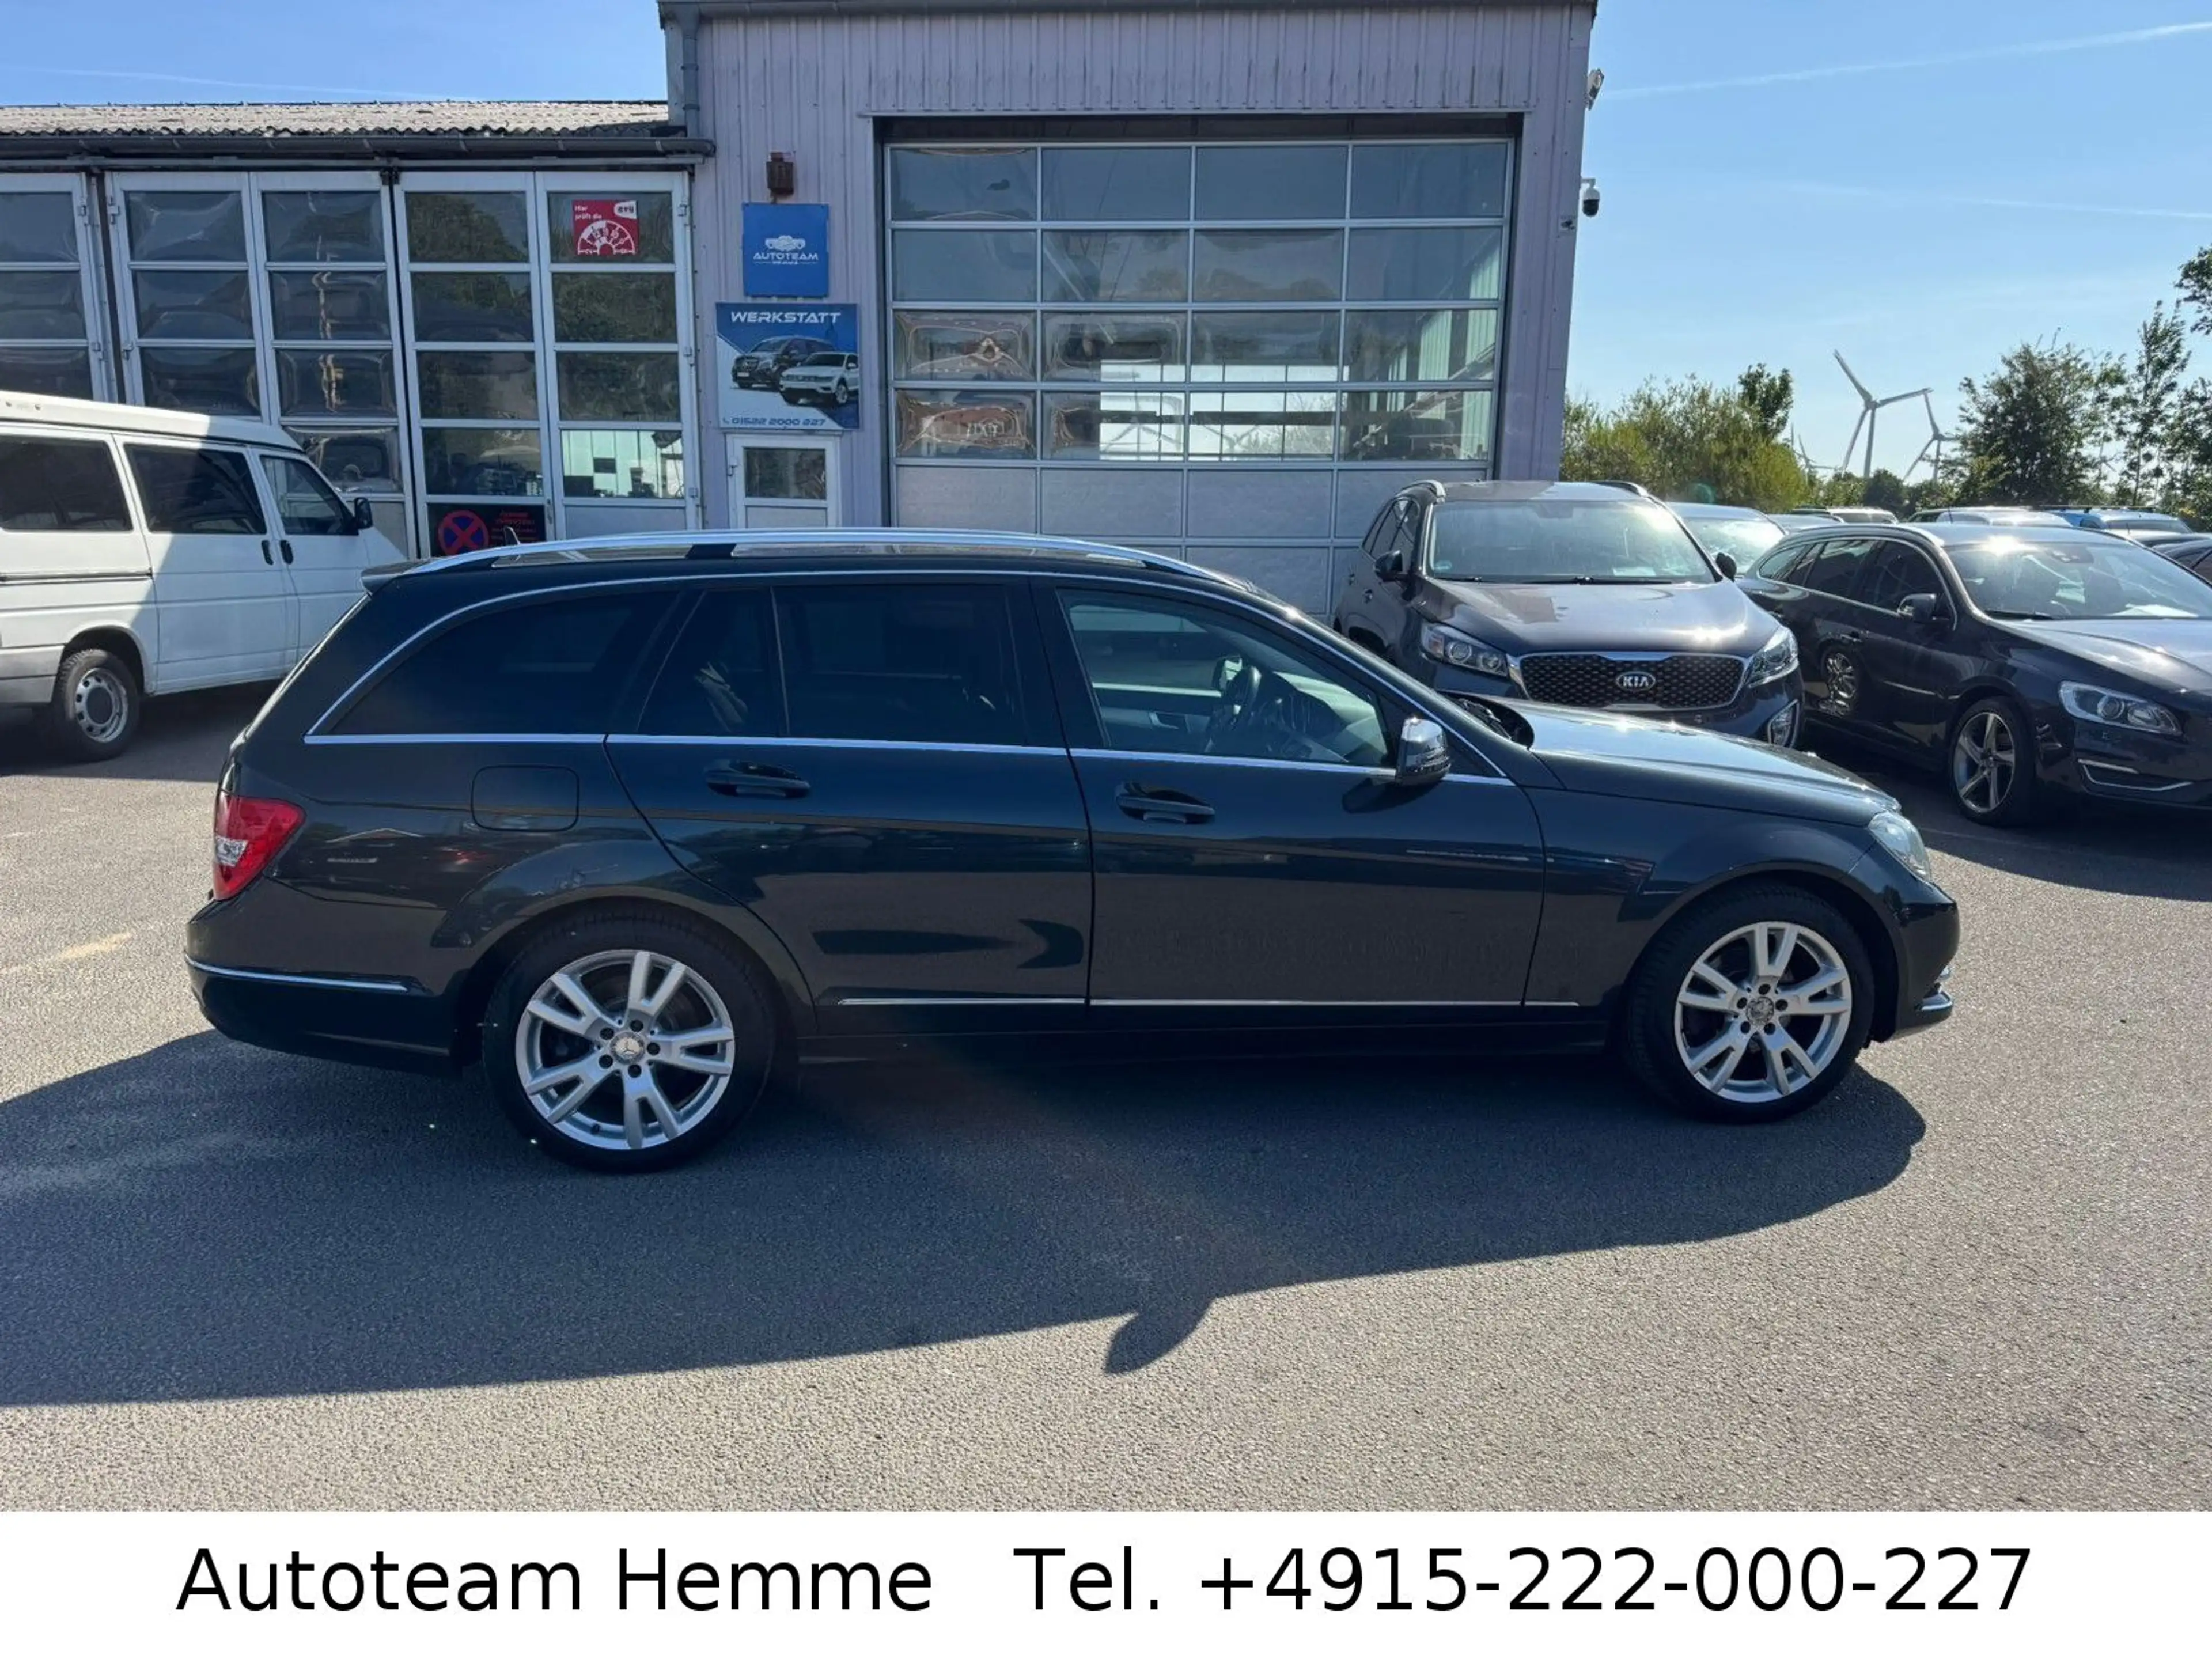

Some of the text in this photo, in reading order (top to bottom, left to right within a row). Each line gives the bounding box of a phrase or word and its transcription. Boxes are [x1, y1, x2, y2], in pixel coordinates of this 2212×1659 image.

[753, 252, 819, 260] AUTOTEAM
[731, 311, 841, 323] WERKSTATT
[1623, 676, 1649, 687] KIA
